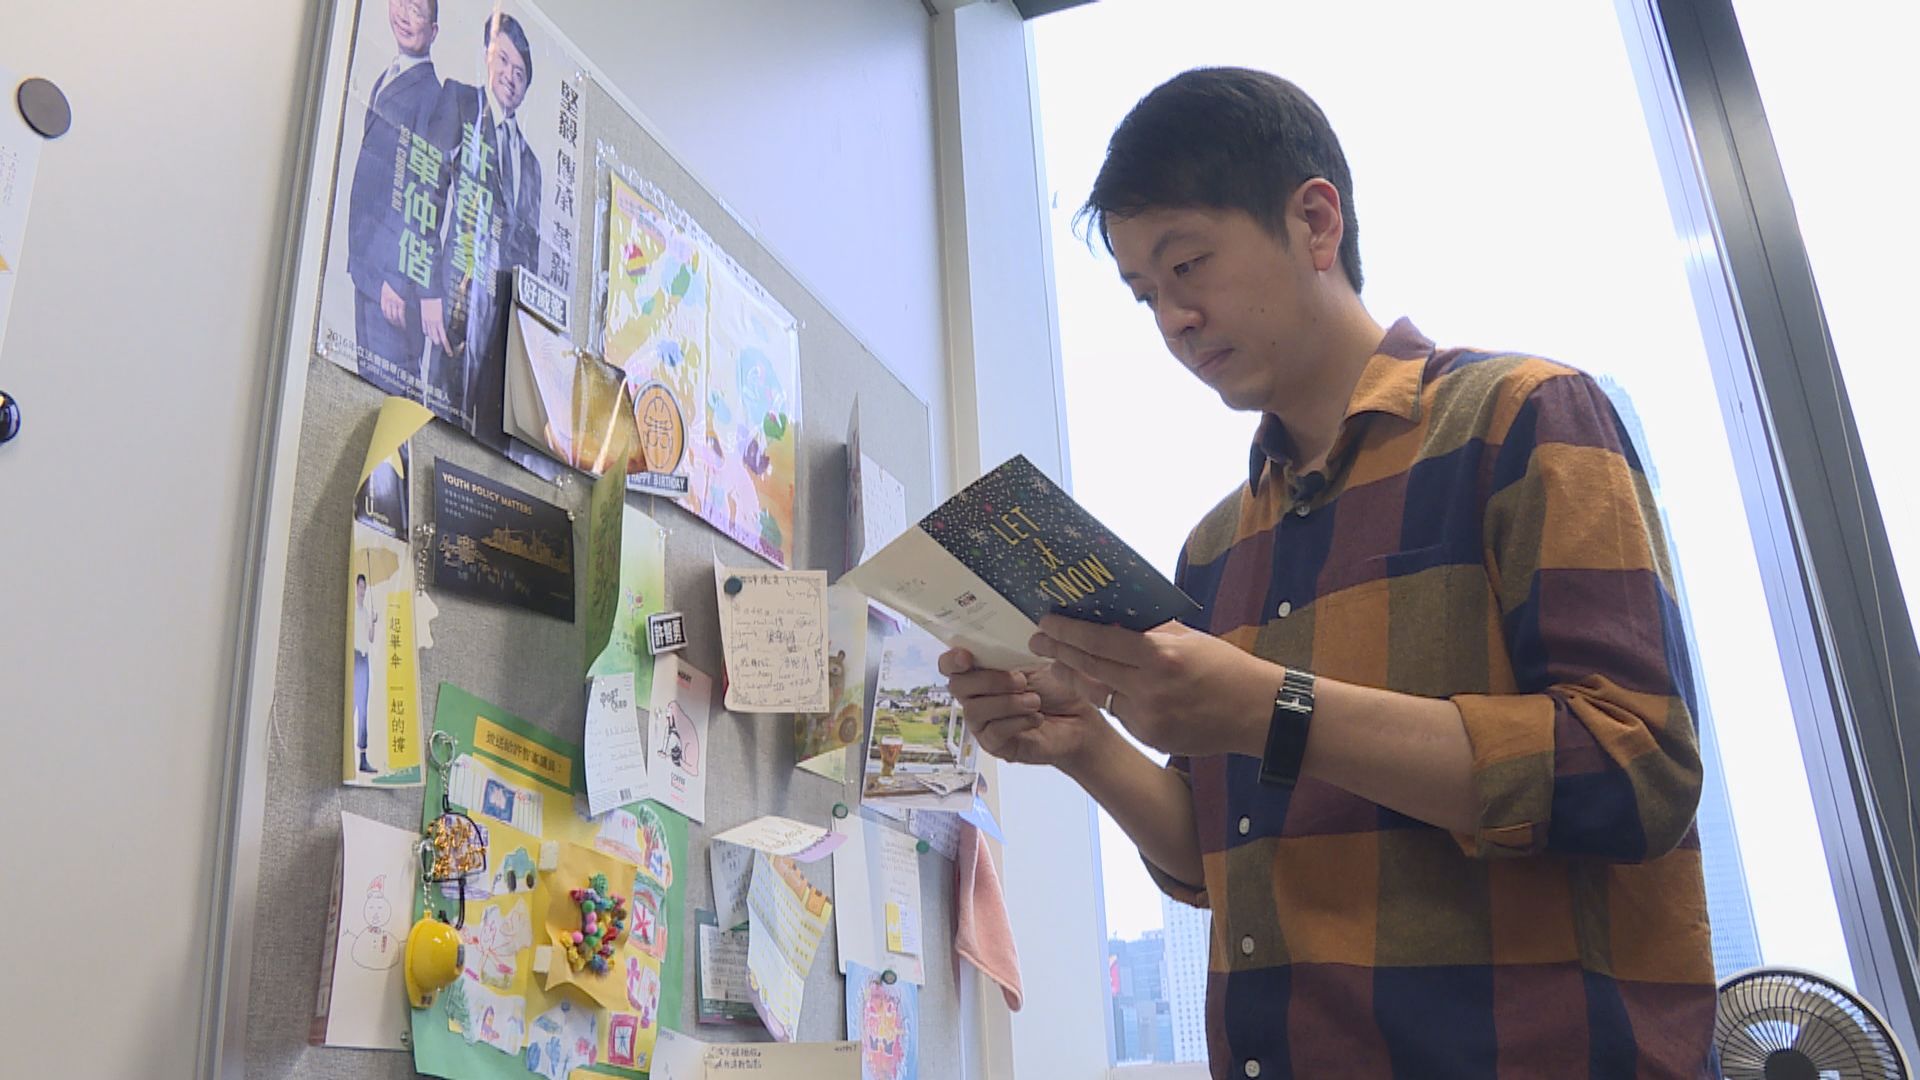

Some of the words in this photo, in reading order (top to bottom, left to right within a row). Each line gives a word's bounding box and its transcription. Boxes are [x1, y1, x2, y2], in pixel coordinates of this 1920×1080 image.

[559, 79, 579, 148] 堅毅
[398, 132, 443, 288] 單仲偕
[554, 148, 577, 218] 傳承
[550, 219, 573, 291] 革新
[442, 471, 470, 491] YOUTH
[471, 483, 500, 503] POLICY
[501, 496, 533, 516] MATTERS
[629, 473, 654, 486] HAPPY
[655, 474, 686, 491] BIRTHDAY
[990, 505, 1040, 546] LET
[1039, 552, 1115, 607] SNOW
[389, 685, 407, 754] 一起的撐
